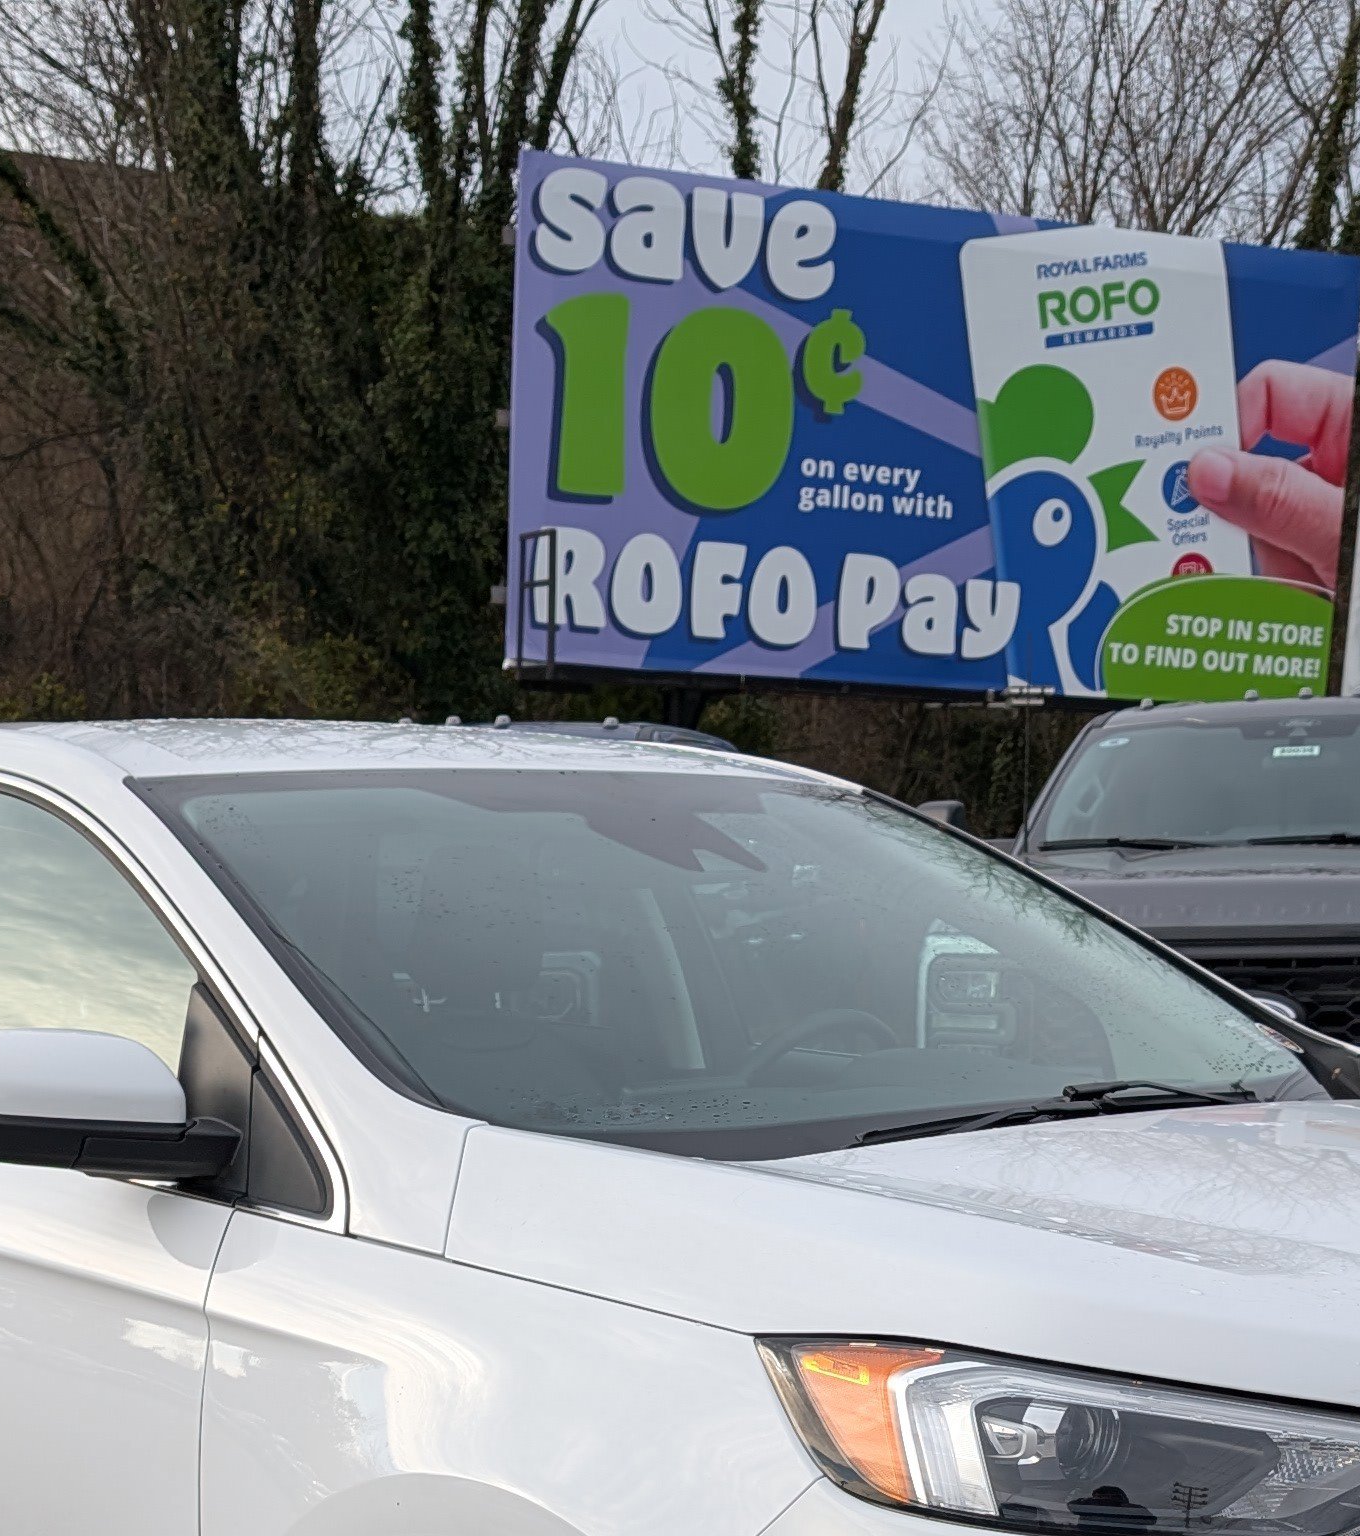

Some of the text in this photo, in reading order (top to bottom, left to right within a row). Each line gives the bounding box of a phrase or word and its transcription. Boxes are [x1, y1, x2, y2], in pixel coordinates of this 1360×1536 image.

[534, 166, 838, 301] save
[1036, 250, 1149, 280] ROYAL FARMS
[1037, 277, 1160, 330] ROFO
[1134, 424, 1224, 449] Royalty Points
[800, 457, 921, 490] on every
[798, 485, 954, 520] gallon with
[1166, 513, 1211, 533] Special
[1171, 531, 1208, 547] Offers
[532, 525, 1022, 660] ROFO Pay
[1165, 613, 1325, 647] STOP IN STORE
[1109, 641, 1322, 679] TO FIND OUT MORE!
